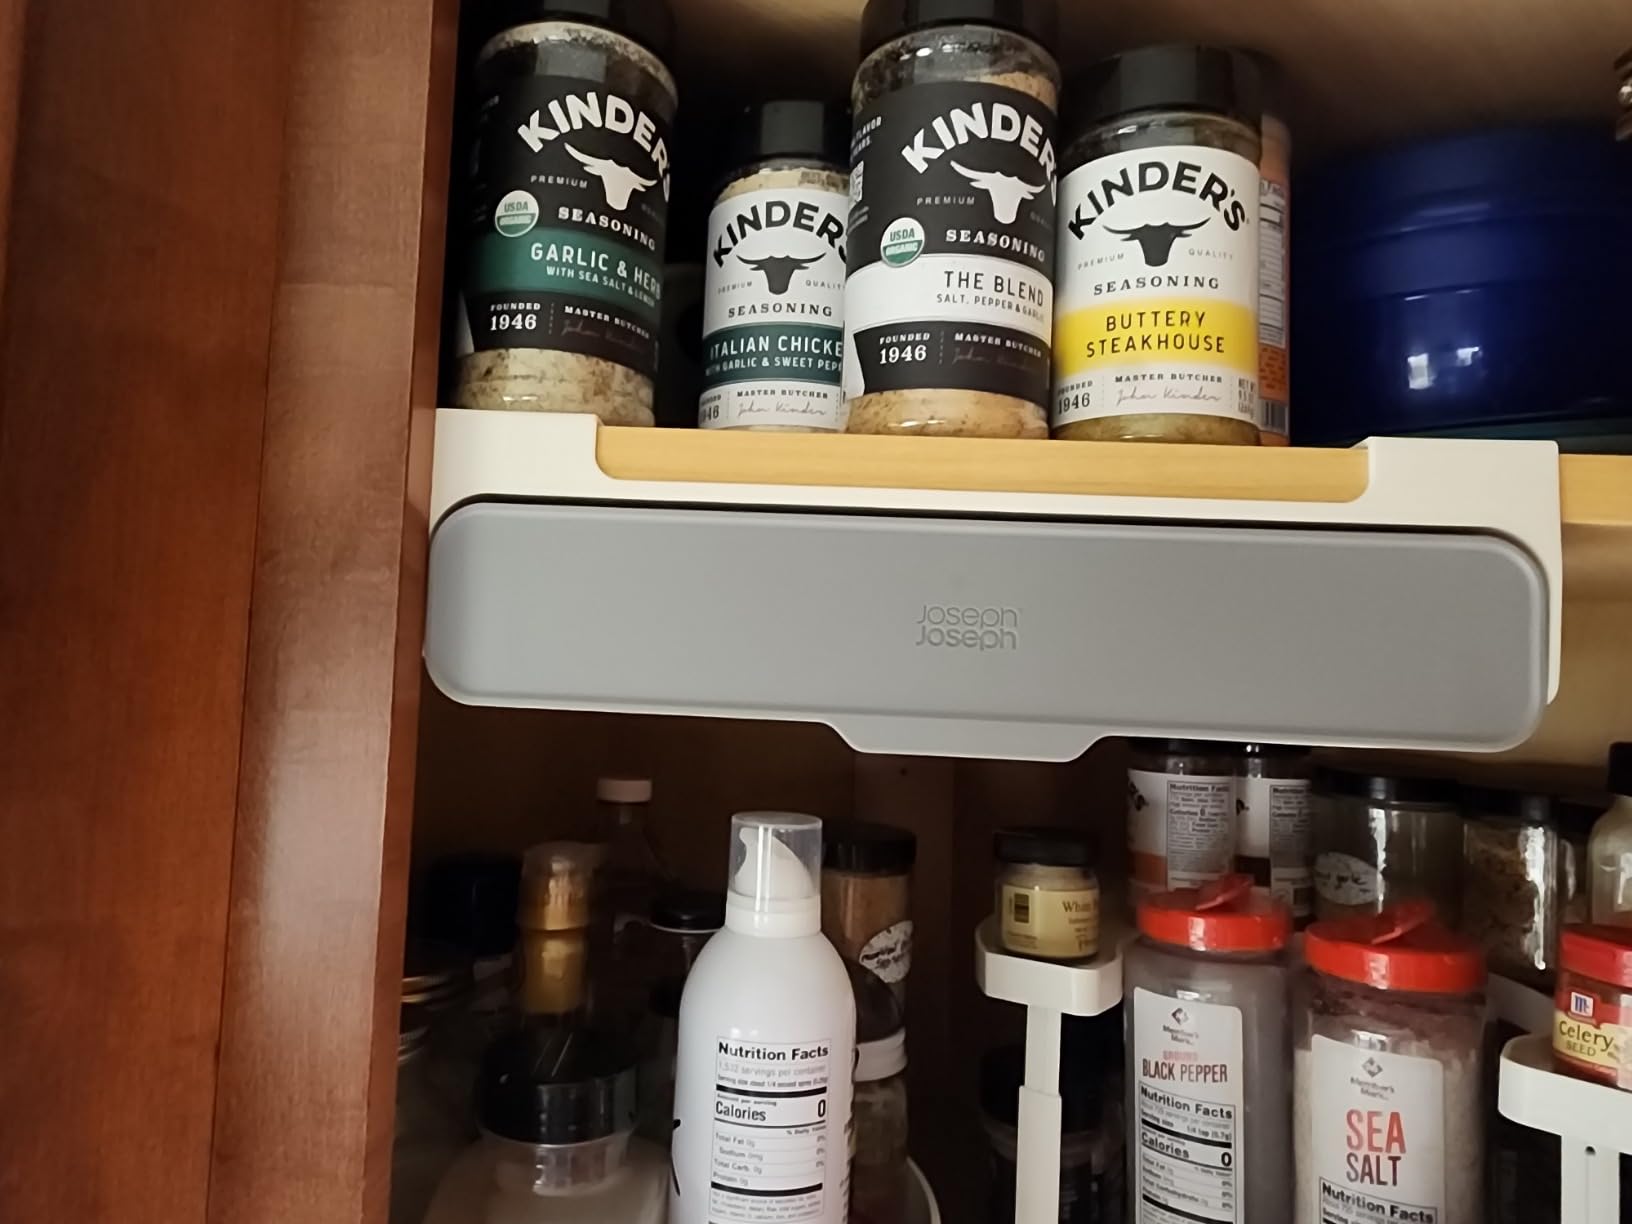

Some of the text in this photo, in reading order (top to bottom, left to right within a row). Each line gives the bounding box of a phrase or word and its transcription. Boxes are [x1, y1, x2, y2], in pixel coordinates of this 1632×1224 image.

[530, 174, 588, 189] PREMIUM
[504, 201, 529, 212] USDA
[917, 197, 975, 206] PREMIUM
[1068, 161, 1246, 241] KINDER'S
[558, 206, 655, 251] SEASONING
[713, 200, 847, 267] KINDER
[890, 228, 915, 241] USDA
[946, 229, 1045, 262] SEASONING
[1188, 248, 1234, 260] QUALITY
[531, 242, 609, 271] GARLIC
[616, 260, 627, 278] &
[1077, 253, 1125, 270] PREMIUM
[546, 265, 575, 278] WITH
[578, 270, 599, 283] SEA
[602, 276, 626, 292] SALT
[944, 271, 1043, 307] THE BLEND
[1093, 276, 1219, 296] SEASONING
[490, 302, 541, 312] FOUNDED
[564, 305, 610, 322] MASTER
[728, 302, 832, 318] SEASONING
[975, 296, 1012, 310] PEPPER
[490, 313, 537, 331] 1946
[1106, 310, 1206, 331] BUTTERY
[710, 335, 769, 360] ITALIAN
[879, 333, 930, 345] FOUNDED
[955, 333, 1001, 346] MASTER
[1087, 334, 1225, 358] STEAKHOUSE
[723, 357, 757, 370] GARLIC
[762, 357, 769, 367] &
[774, 357, 813, 368] SWEET
[879, 345, 927, 364] 1946
[1115, 373, 1223, 383] MASTER BUTCHER
[781, 389, 828, 398] BUTCHER
[1058, 393, 1091, 414] 1946
[916, 605, 1018, 628] Joseph
[916, 625, 1017, 651] Joseph
[1559, 1020, 1614, 1052] Celery
[718, 1041, 829, 1061] Nutrition Facts
[1566, 1040, 1596, 1057] SEED
[1142, 1058, 1229, 1084] BLACK PEPPER
[716, 1099, 826, 1121] Calories 0
[1141, 1086, 1190, 1111] Nutrition
[1195, 1103, 1233, 1120] Facts
[1346, 1109, 1407, 1154] SEA
[1141, 1131, 1190, 1160] Calories
[1220, 1151, 1233, 1168] 0
[1346, 1152, 1402, 1187] SALT
[1322, 1182, 1386, 1215] Nutrition
[1389, 1204, 1434, 1223] Facts
